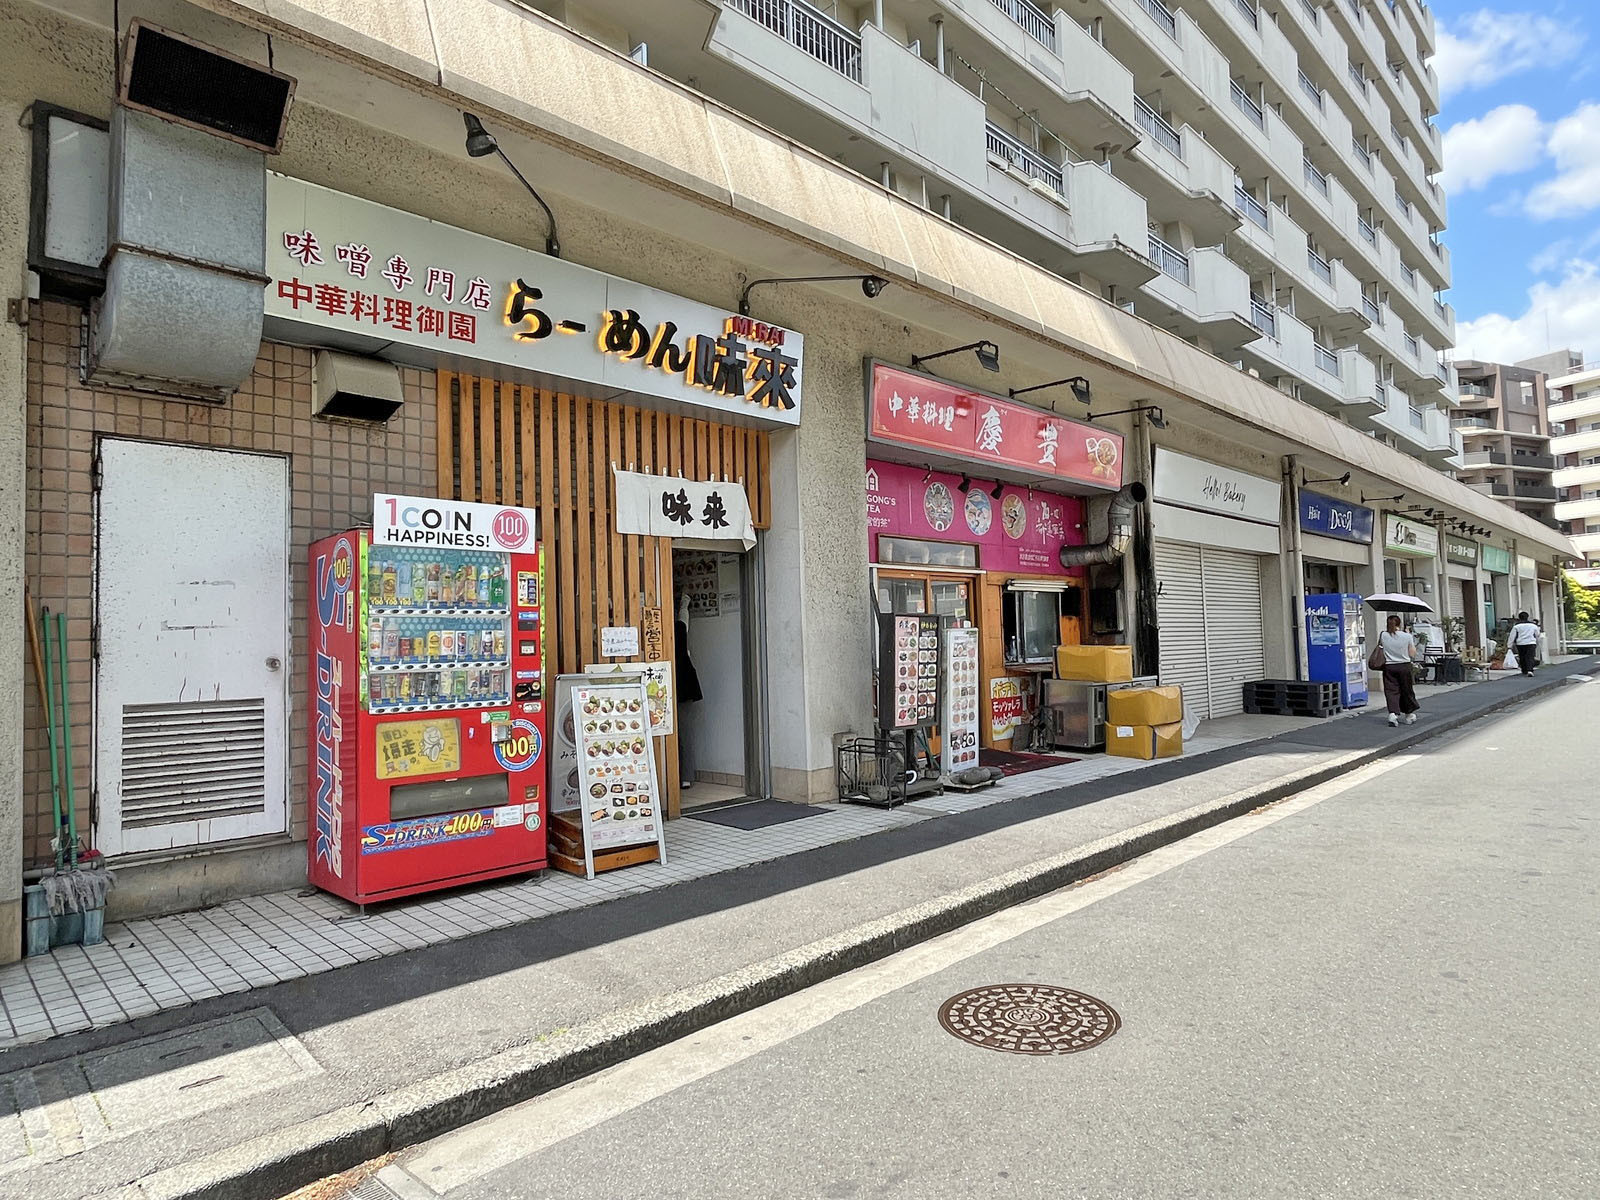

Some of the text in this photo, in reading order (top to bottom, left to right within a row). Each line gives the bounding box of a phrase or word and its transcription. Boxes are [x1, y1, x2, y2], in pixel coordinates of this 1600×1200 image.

[284, 231, 491, 311] 味噌専門店
[277, 277, 477, 344] 中華料理御園
[732, 315, 786, 346] MIRAI
[888, 391, 956, 432] 中華料理
[661, 487, 731, 530] 味来
[866, 494, 896, 506] GONG'S
[866, 503, 881, 513] TEA
[1223, 482, 1247, 511] Bakery
[498, 514, 524, 537] 100
[1308, 505, 1321, 520] Hair
[387, 528, 490, 547] HAPPINESS!
[363, 824, 448, 849] S-DRINK
